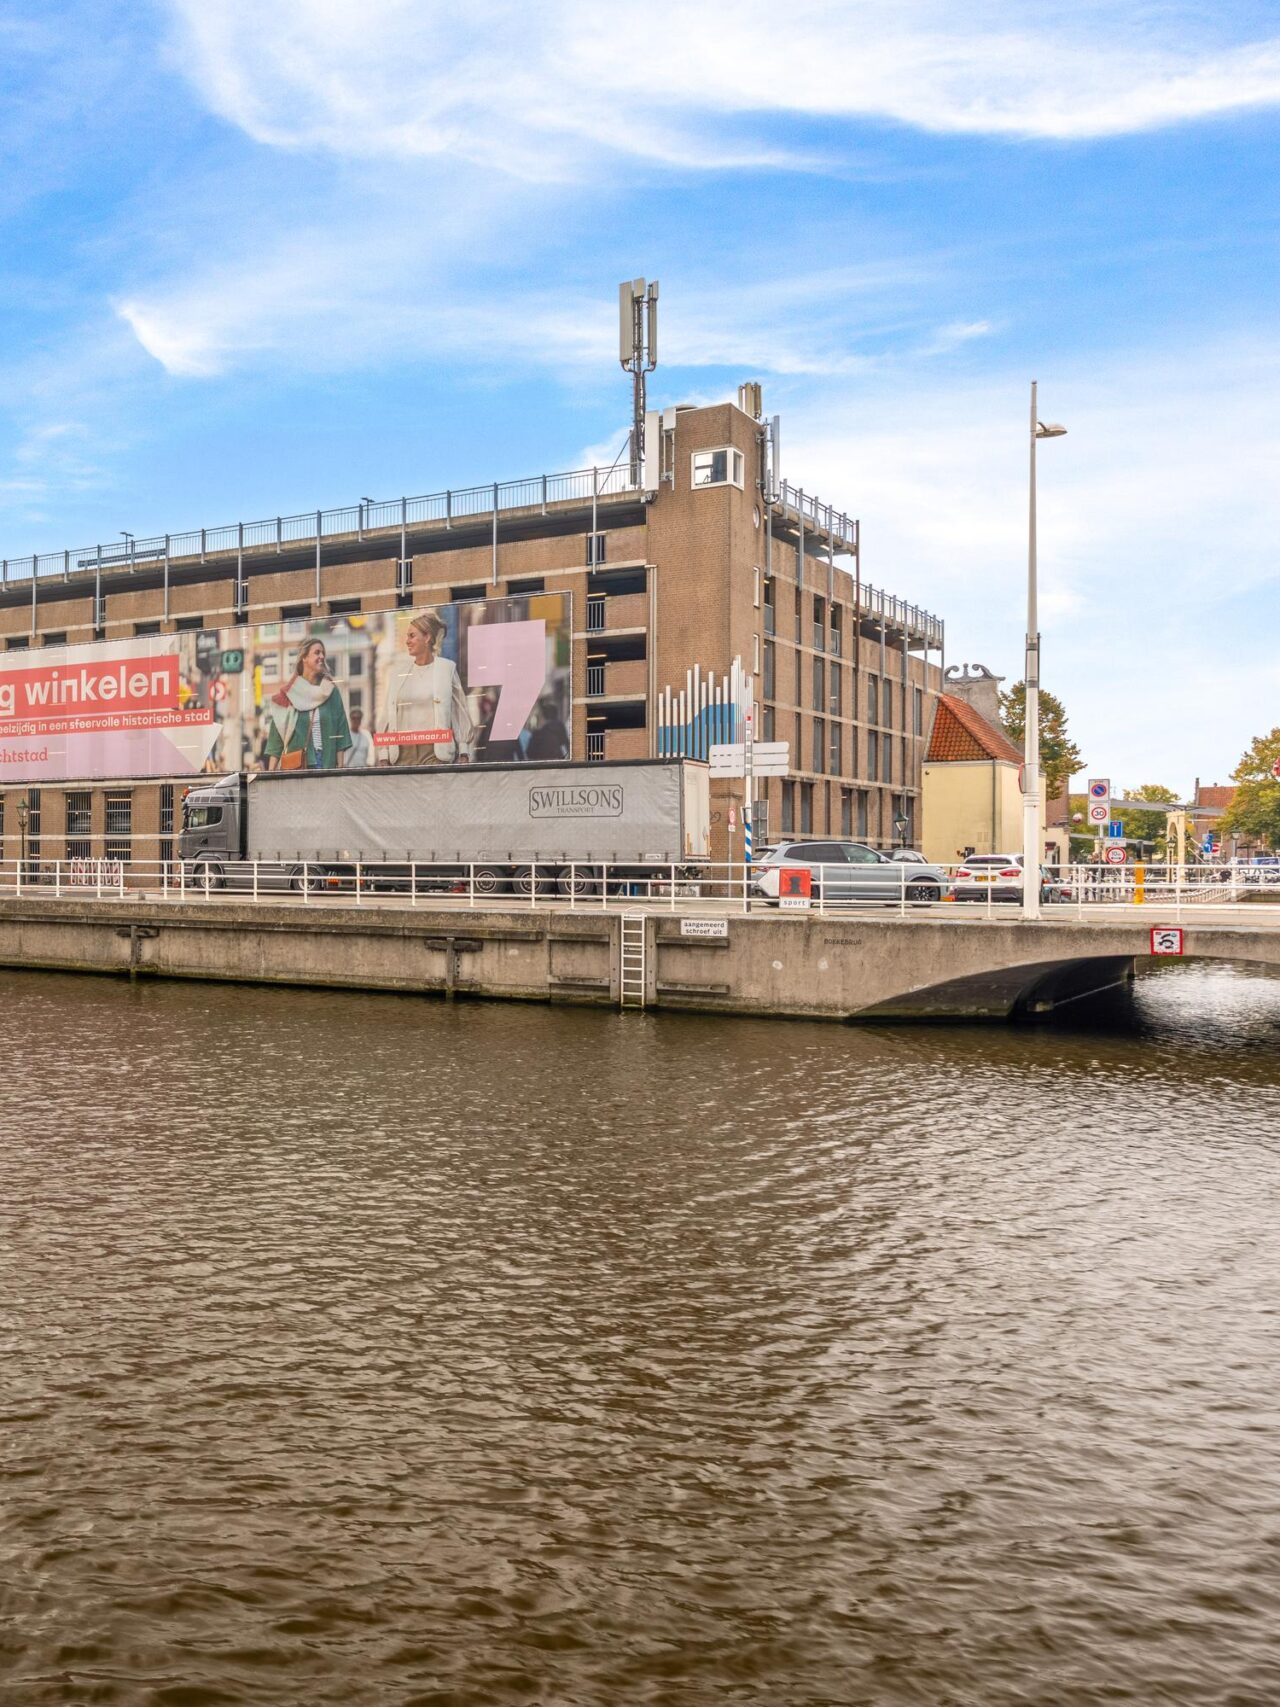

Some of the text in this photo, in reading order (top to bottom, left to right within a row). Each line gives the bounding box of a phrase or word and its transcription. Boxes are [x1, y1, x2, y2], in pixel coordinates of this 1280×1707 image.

[25, 666, 170, 705] winkelen
[38, 722, 47, 731] in
[49, 723, 68, 731] een
[69, 717, 120, 730] sfeervolle
[122, 714, 182, 726] historische
[184, 710, 211, 721] stad
[376, 731, 449, 743] www.inalkmaar.nl
[531, 789, 620, 811] SWILLSONS
